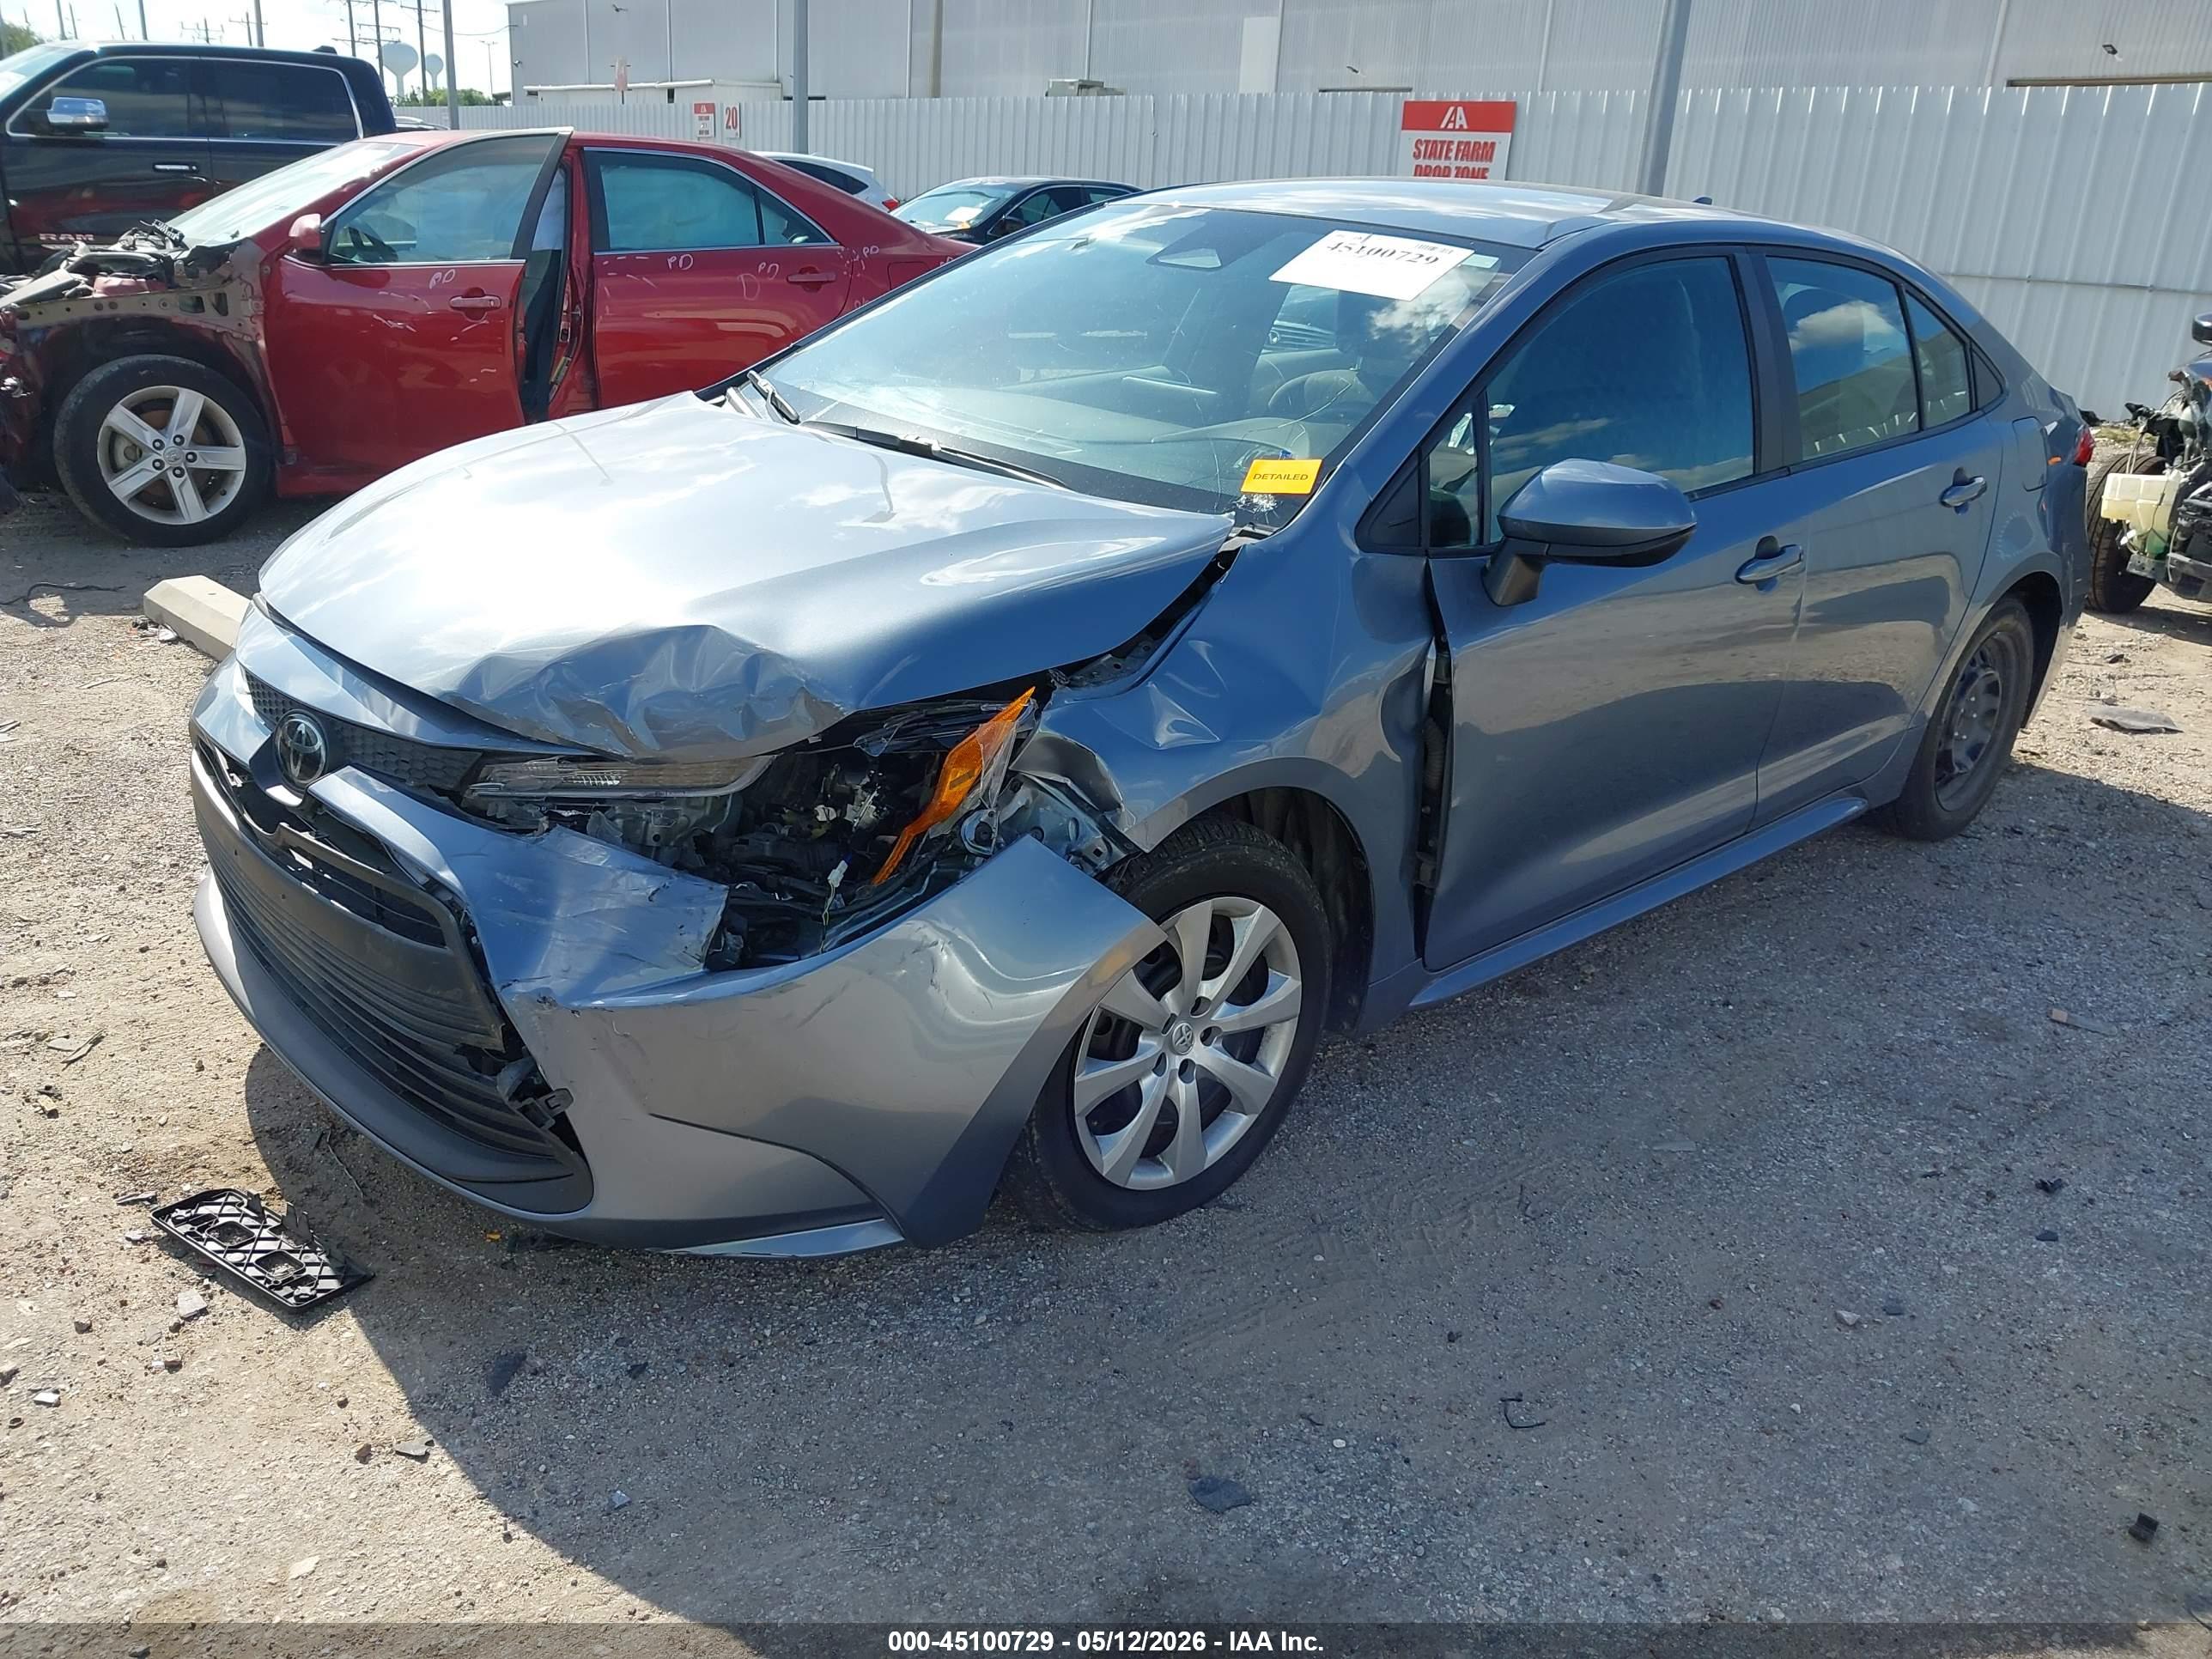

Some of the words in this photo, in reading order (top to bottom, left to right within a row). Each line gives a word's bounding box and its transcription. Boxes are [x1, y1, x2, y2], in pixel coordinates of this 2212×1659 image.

[726, 106, 738, 130] 20
[1413, 138, 1454, 161] STATE
[1455, 140, 1496, 162] FARM
[1413, 164, 1451, 178] DROP
[1454, 166, 1489, 179] ZONE
[667, 254, 694, 270] PD
[1328, 241, 1440, 265] 45100729
